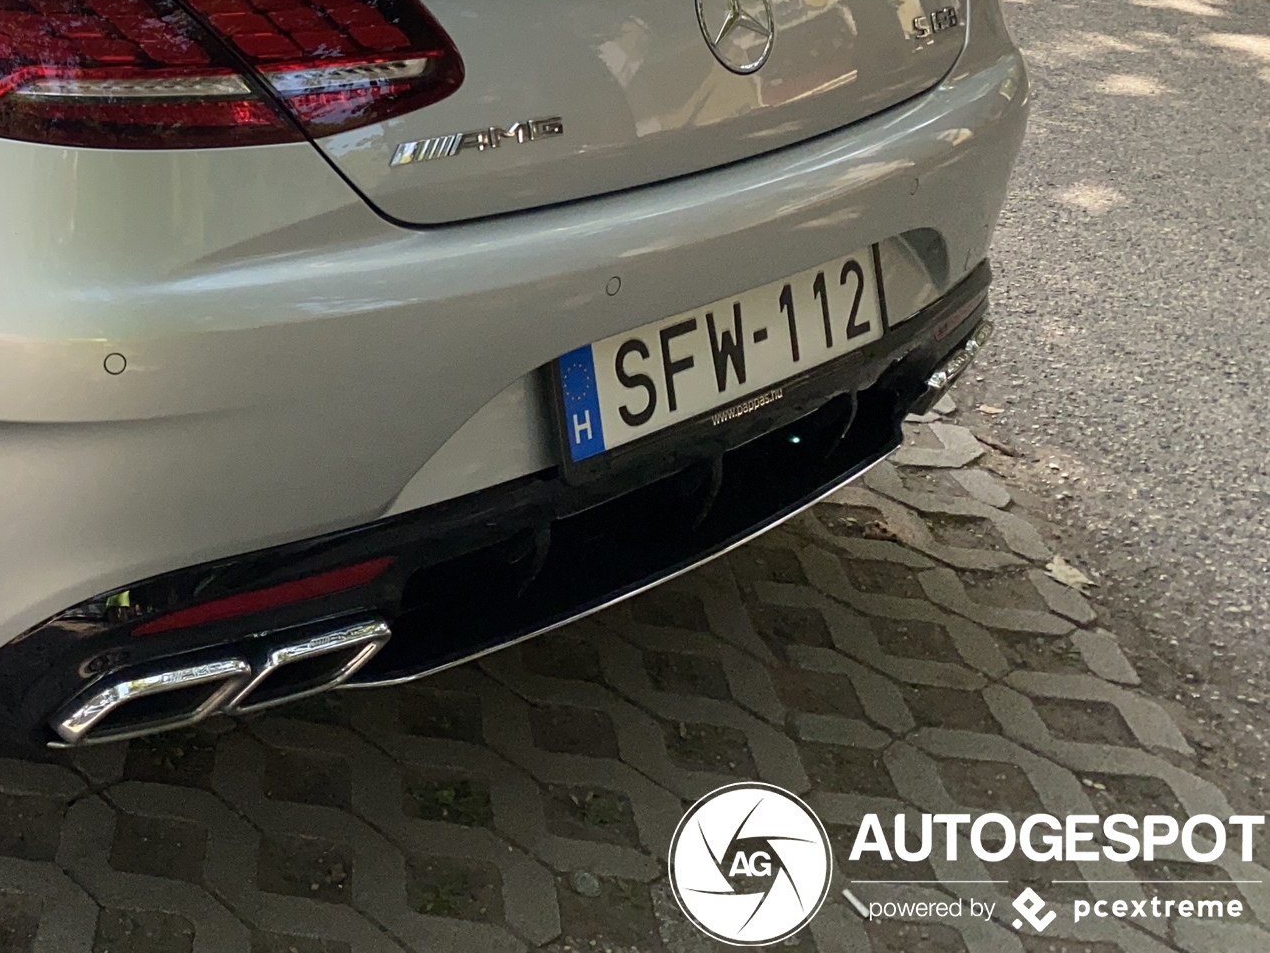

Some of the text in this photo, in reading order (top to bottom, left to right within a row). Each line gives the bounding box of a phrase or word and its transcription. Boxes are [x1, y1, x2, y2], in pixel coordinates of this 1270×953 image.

[614, 258, 871, 427] SFW-112
[711, 388, 784, 426] www.pappas.hu
[573, 410, 593, 444] H
